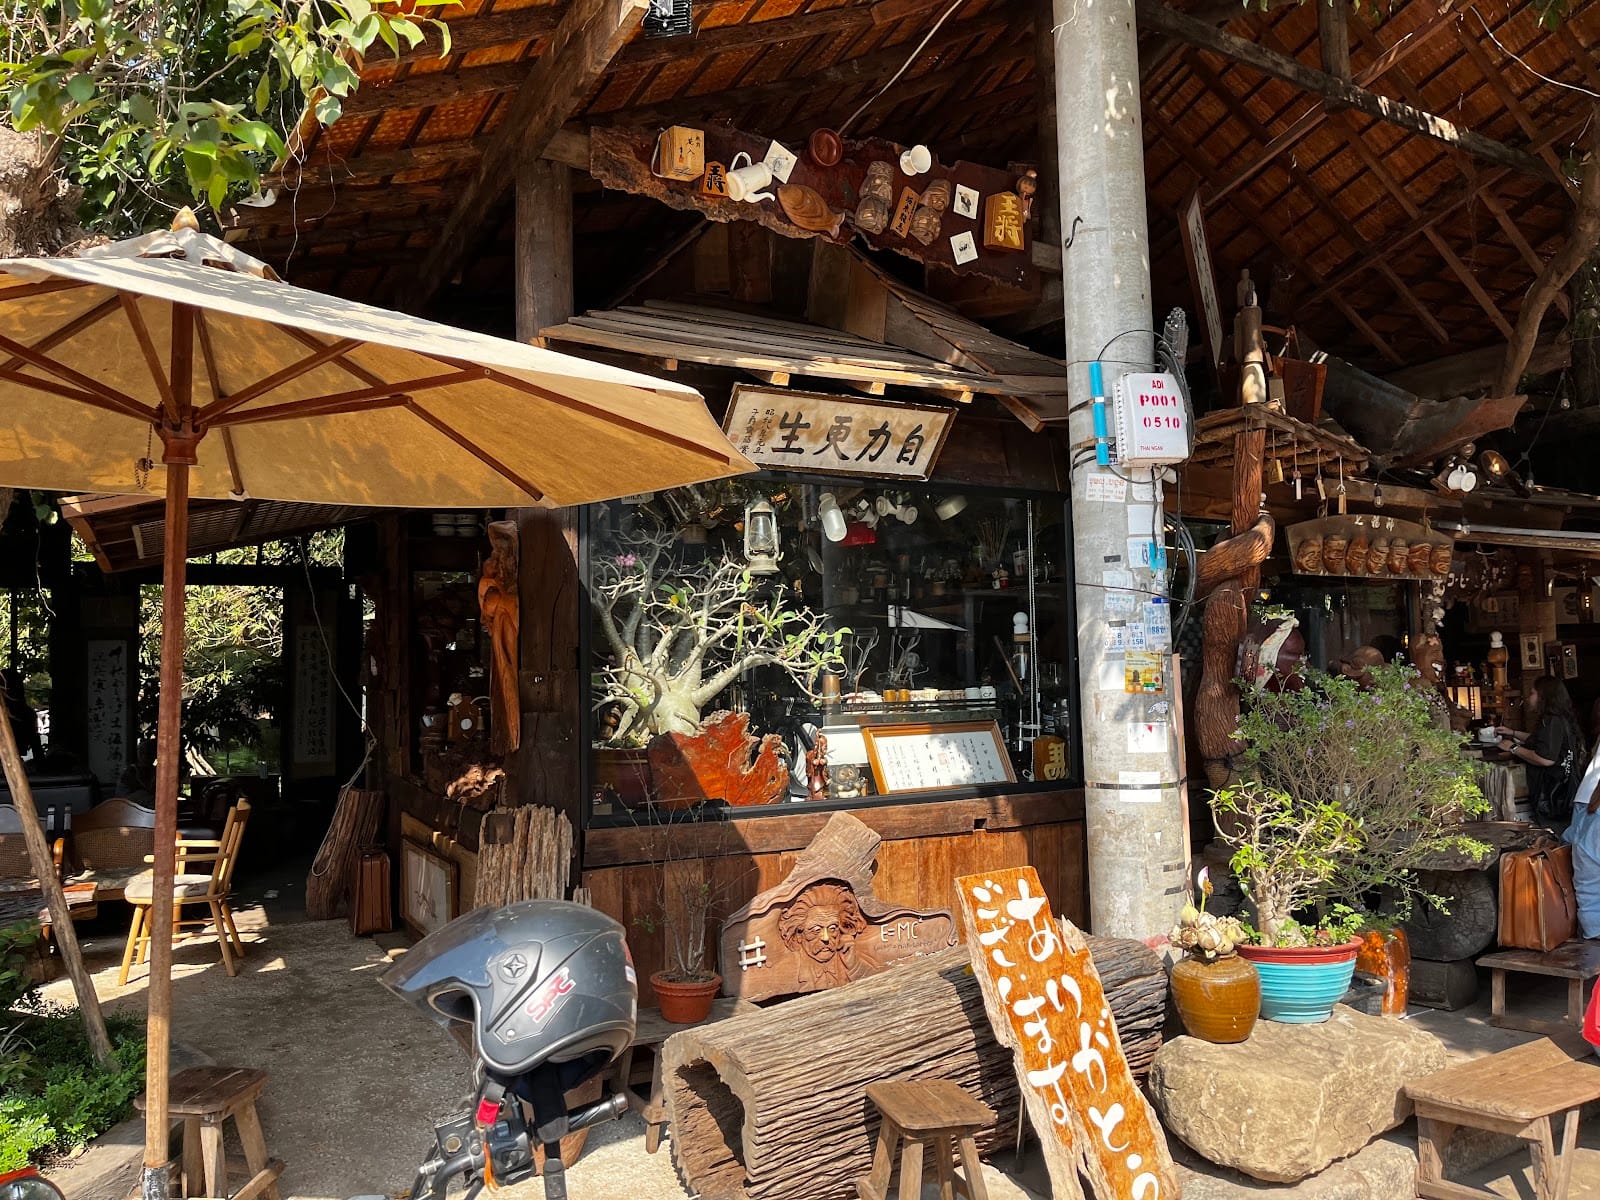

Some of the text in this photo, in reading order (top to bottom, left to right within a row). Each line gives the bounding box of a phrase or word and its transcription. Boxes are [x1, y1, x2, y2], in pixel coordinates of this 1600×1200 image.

[1139, 394, 1177, 407] P001
[1143, 416, 1180, 429] 0510
[972, 879, 1070, 1126] ございます
[1005, 878, 1160, 1200] ありがとう
